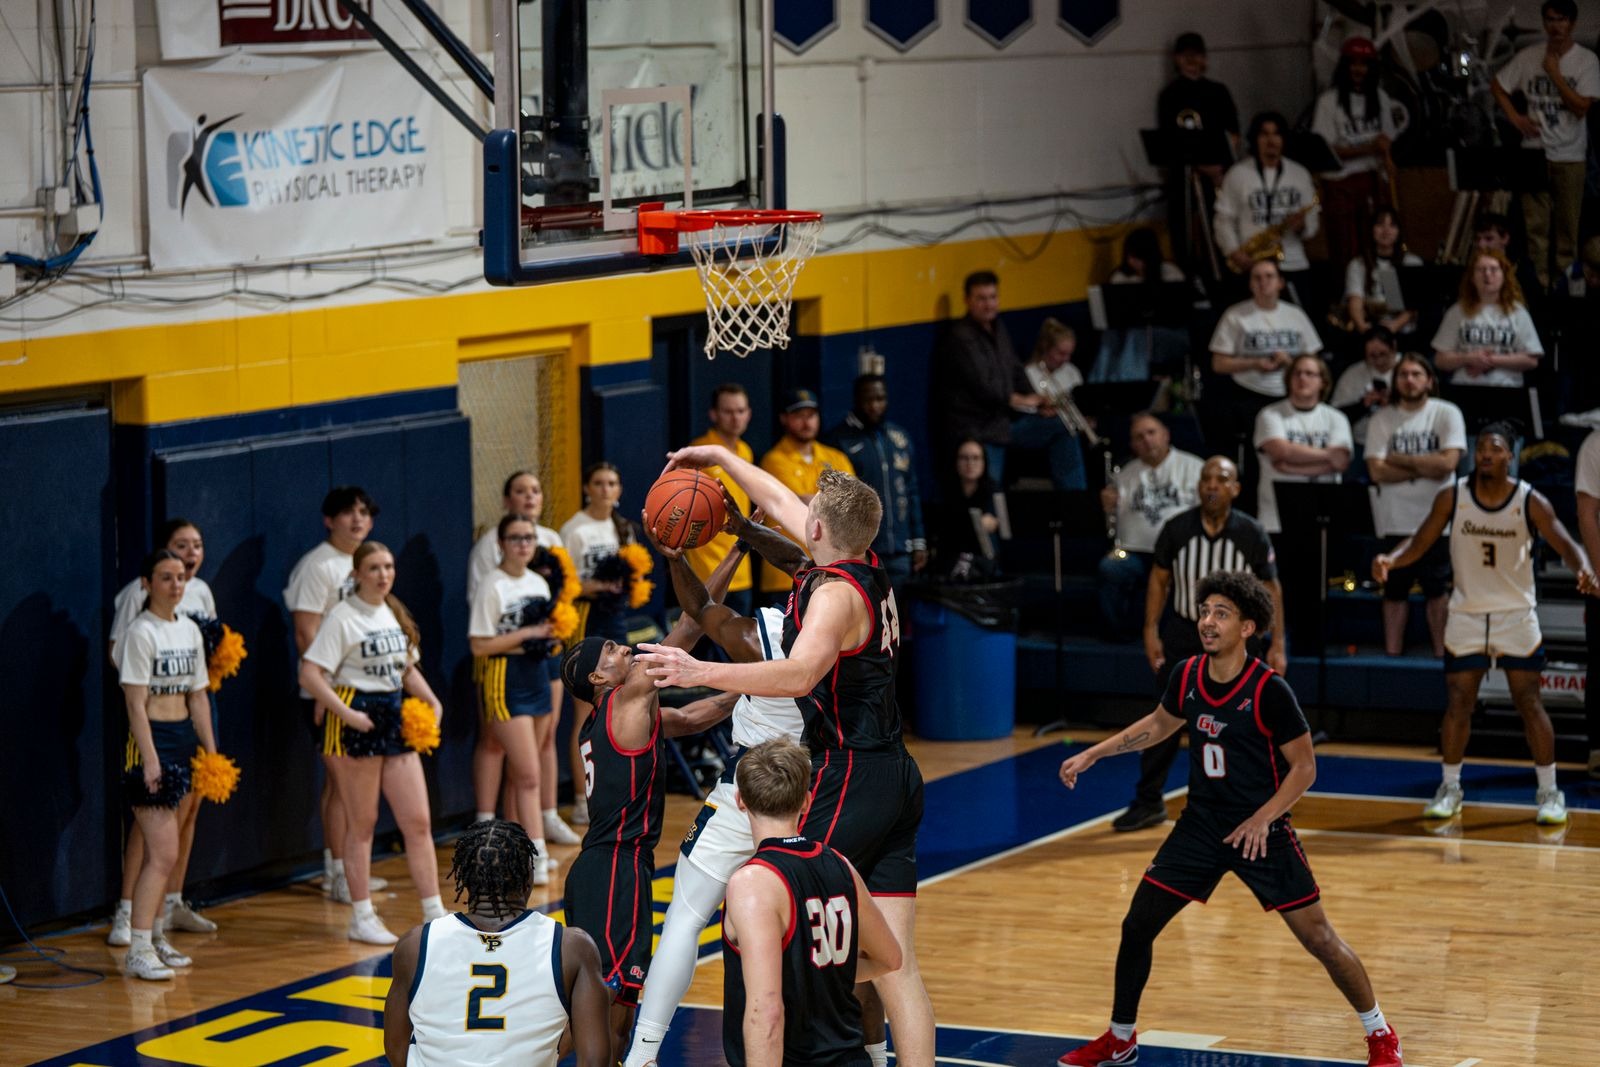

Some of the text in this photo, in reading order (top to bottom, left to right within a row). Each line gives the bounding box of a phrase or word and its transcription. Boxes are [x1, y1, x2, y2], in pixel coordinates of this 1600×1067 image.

[243, 116, 426, 171] KINETIC EDGE
[252, 163, 427, 206] PHYSICAL THERAPY
[1481, 540, 1497, 569] 3
[1196, 713, 1228, 738] GV
[1202, 742, 1227, 779] 0
[804, 895, 853, 969] 30
[464, 961, 510, 1033] 2
